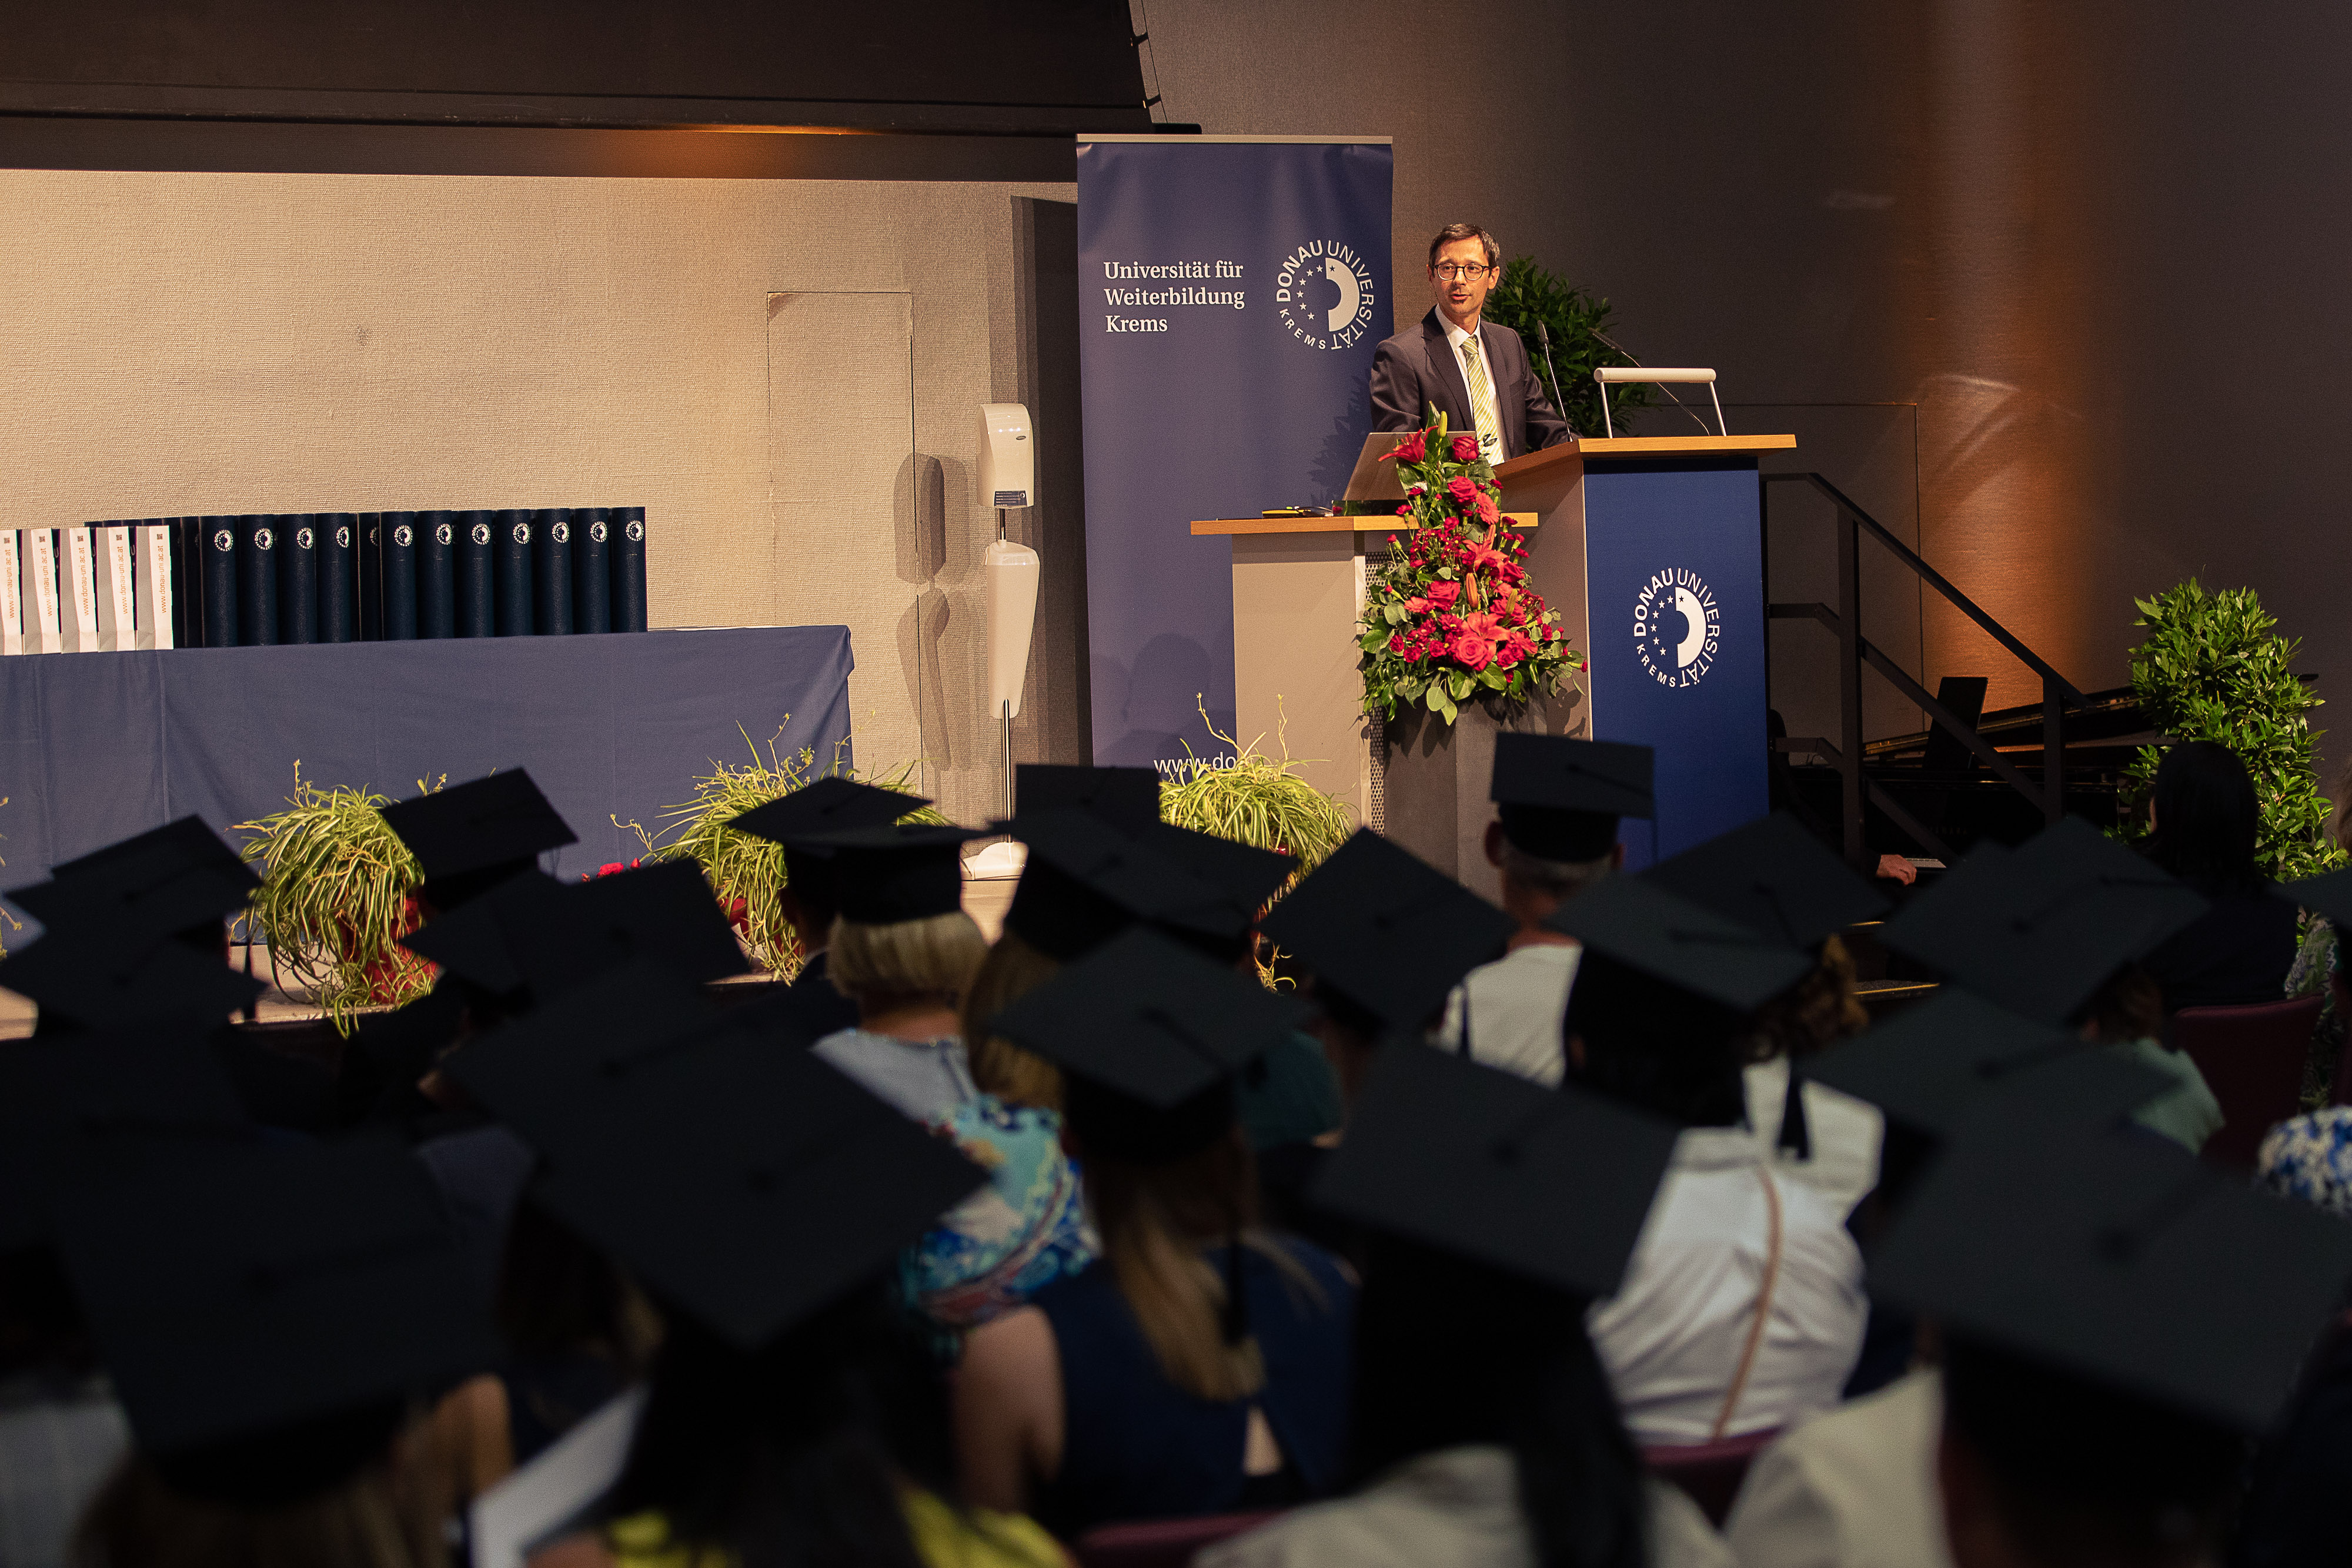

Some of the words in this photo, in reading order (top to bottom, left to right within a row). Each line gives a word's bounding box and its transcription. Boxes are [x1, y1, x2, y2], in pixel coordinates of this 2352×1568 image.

[1103, 260, 1211, 279] Universität
[1215, 260, 1244, 278] für
[1103, 286, 1245, 310] Weiterbildung
[1276, 239, 1324, 303] DONAU
[1327, 239, 1375, 350] UNIVERSITÄT
[1105, 315, 1168, 333] Krems
[1279, 308, 1327, 350] KREMS
[5, 549, 15, 618] www.donau-uni.ac.at
[40, 547, 52, 617] www.donau-uni.ac.at
[78, 547, 89, 616] www.donau-uni.ac.at
[117, 546, 128, 614] www.donau-uni.ac.at
[158, 546, 167, 614] www.donau-uni.ac.at
[1633, 567, 1674, 637] DONAU
[1676, 567, 1720, 688] UNIVERSITÄT
[1636, 643, 1676, 688] KREMS
[1154, 751, 1237, 773] www.do
